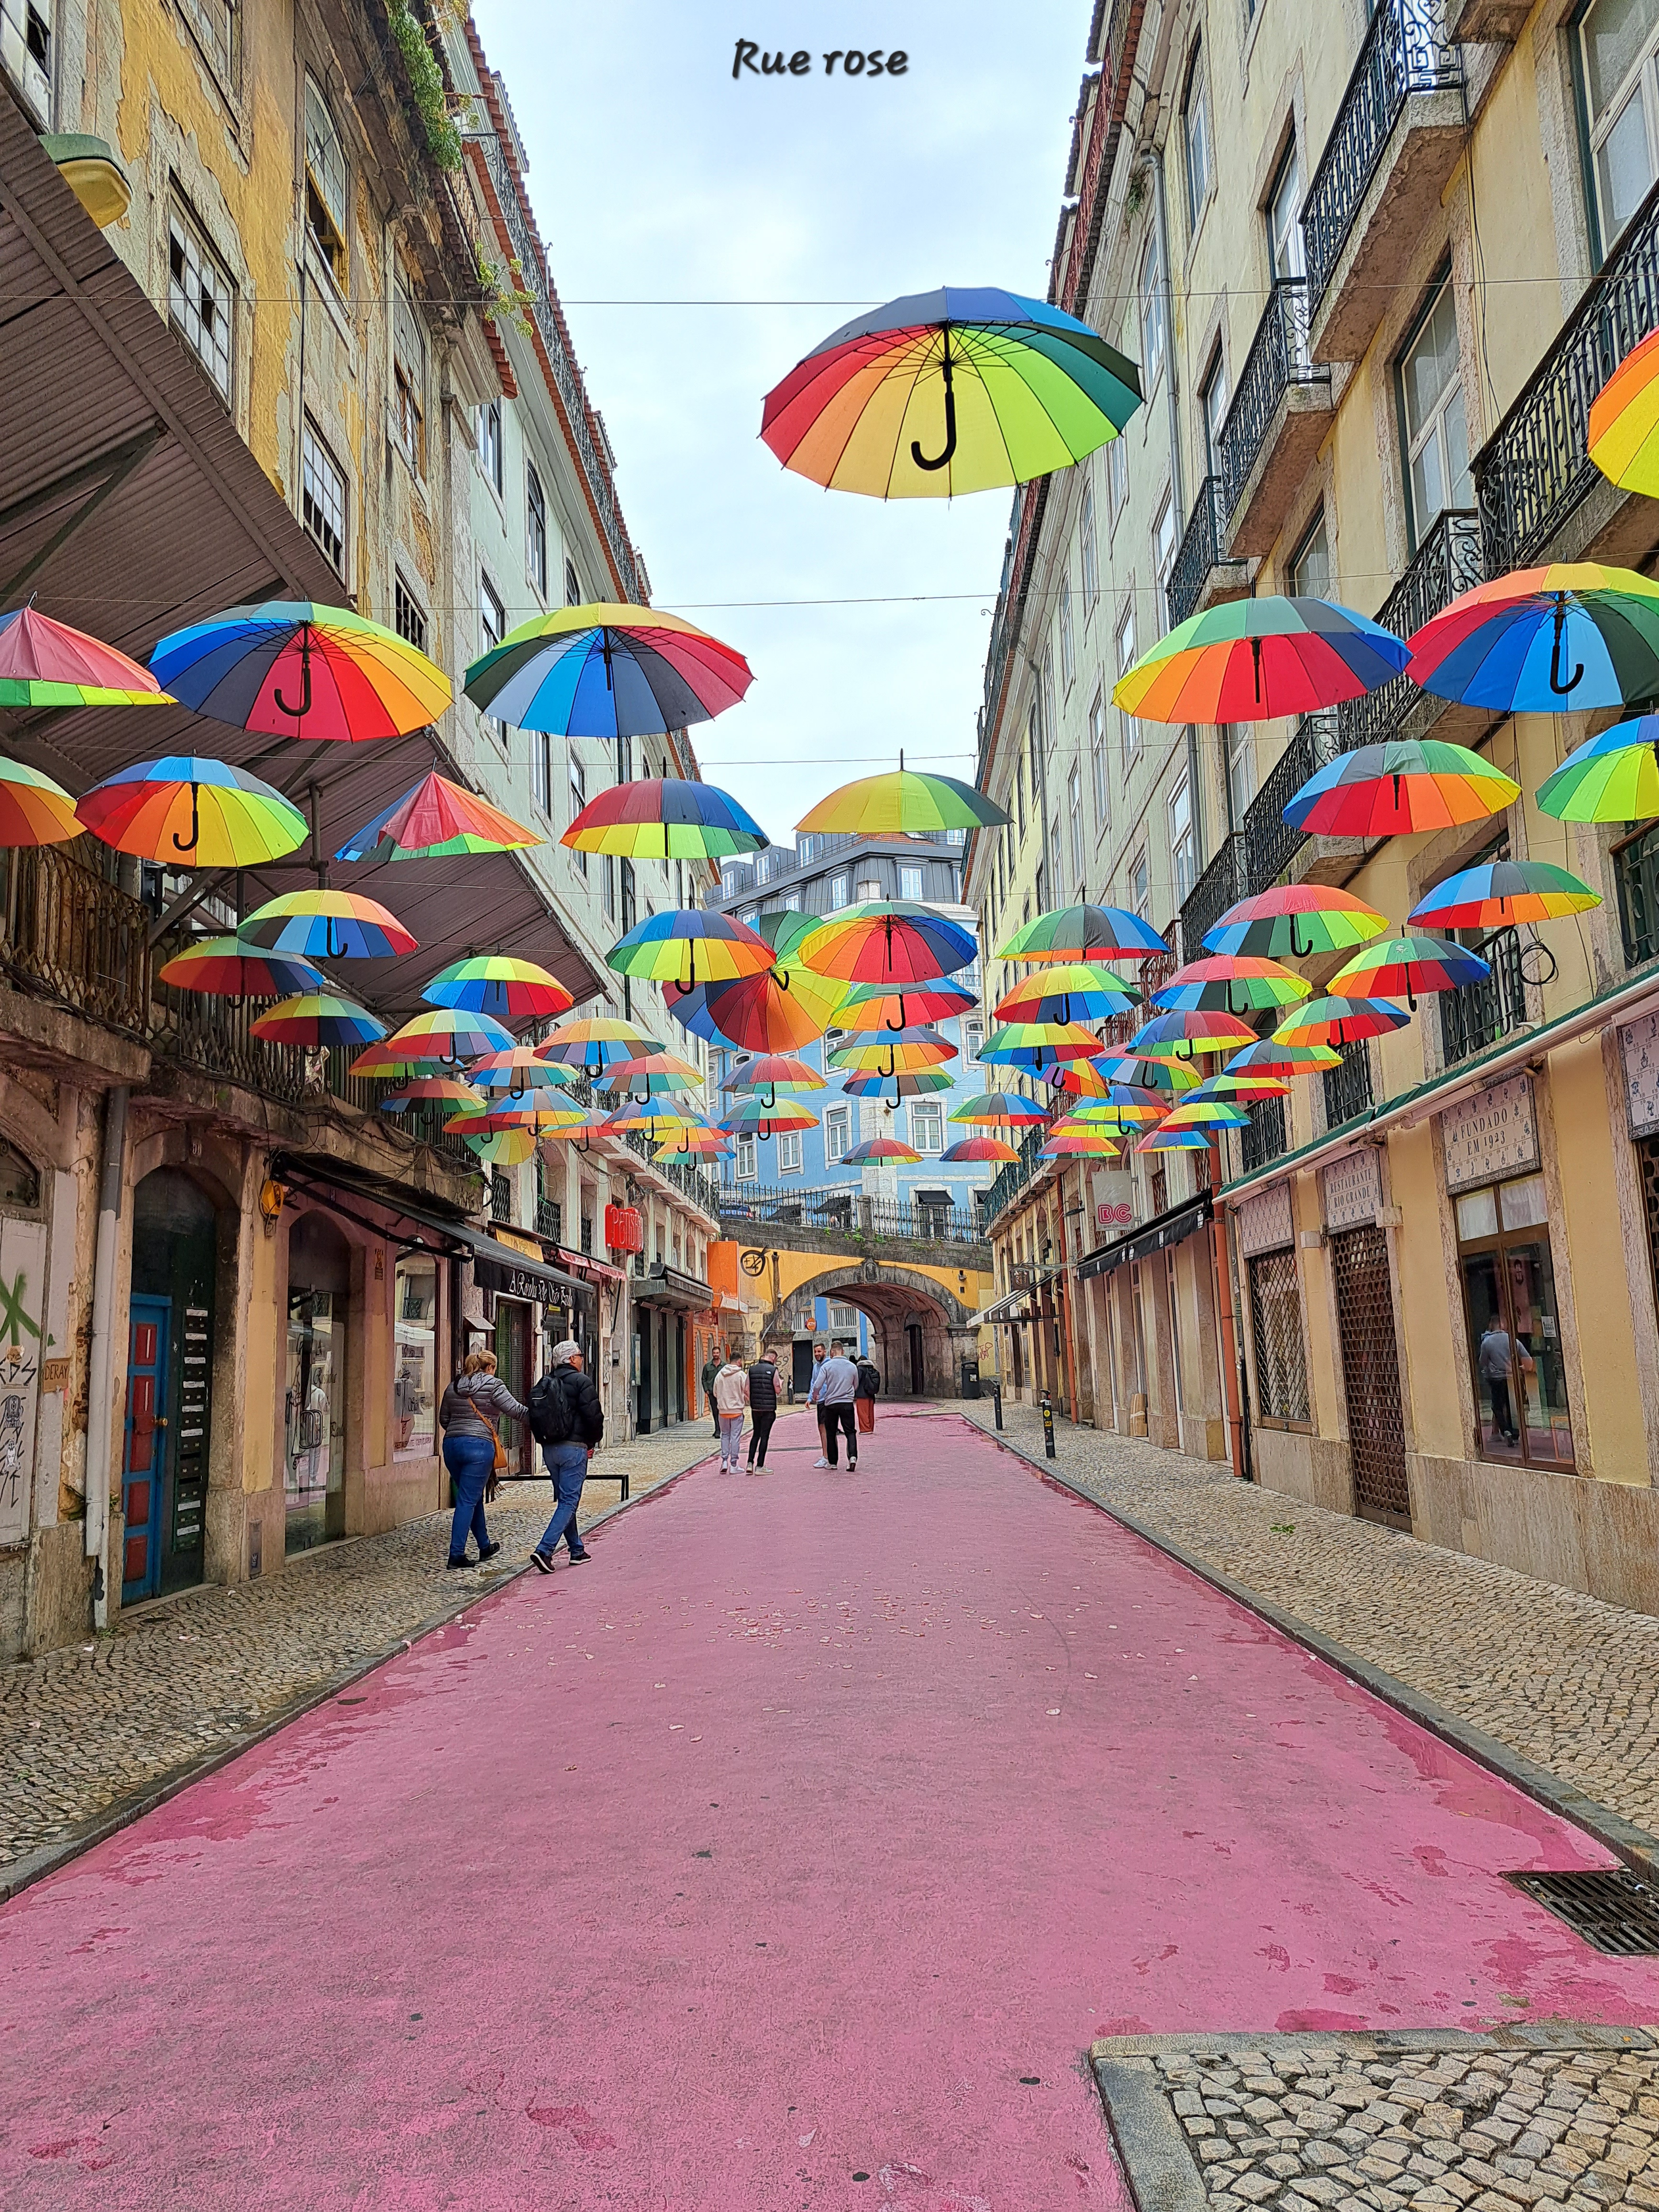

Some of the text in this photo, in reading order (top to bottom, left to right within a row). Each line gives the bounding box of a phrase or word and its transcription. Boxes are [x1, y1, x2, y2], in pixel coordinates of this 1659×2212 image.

[1461, 1108, 1507, 1139] FUNDADO
[1467, 1130, 1505, 1155] EM 1923
[1330, 1168, 1372, 1194] RESTAURANTE
[1334, 1185, 1371, 1208] RIO GRANDE
[1098, 1204, 1132, 1224] BC
[509, 1269, 516, 1293] A
[44, 1364, 68, 1381] DERAY
